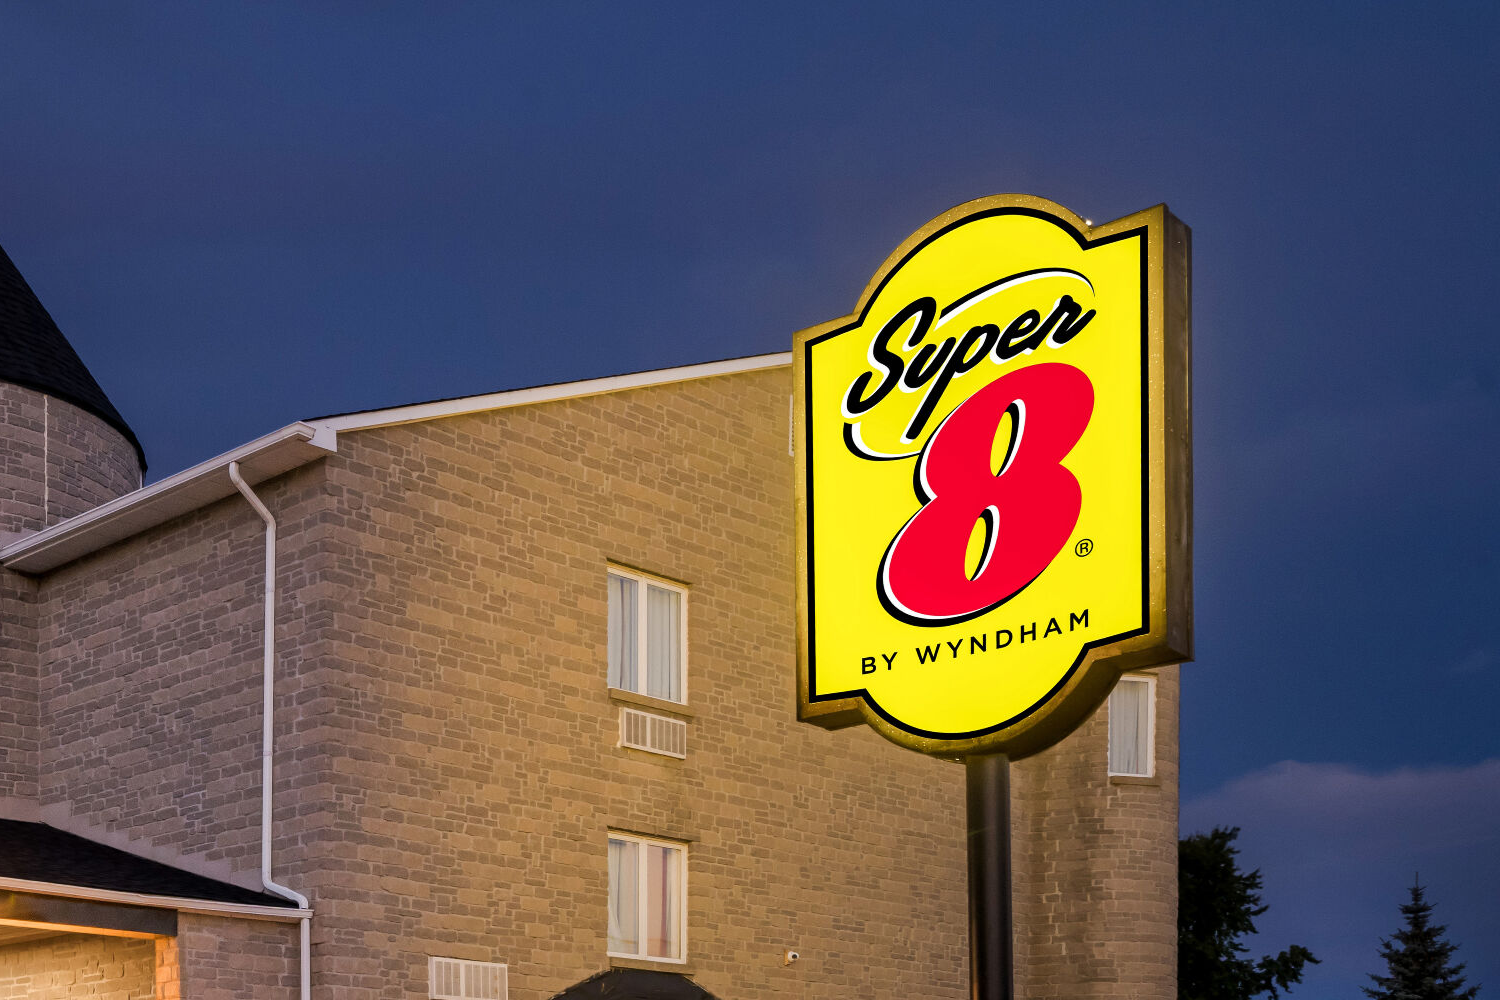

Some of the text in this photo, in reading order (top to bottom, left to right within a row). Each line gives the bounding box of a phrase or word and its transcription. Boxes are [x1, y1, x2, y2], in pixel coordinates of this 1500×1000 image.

[845, 295, 1097, 441] Super
[876, 363, 1095, 627] 8
[861, 608, 1089, 675] BY WYNDHAM
